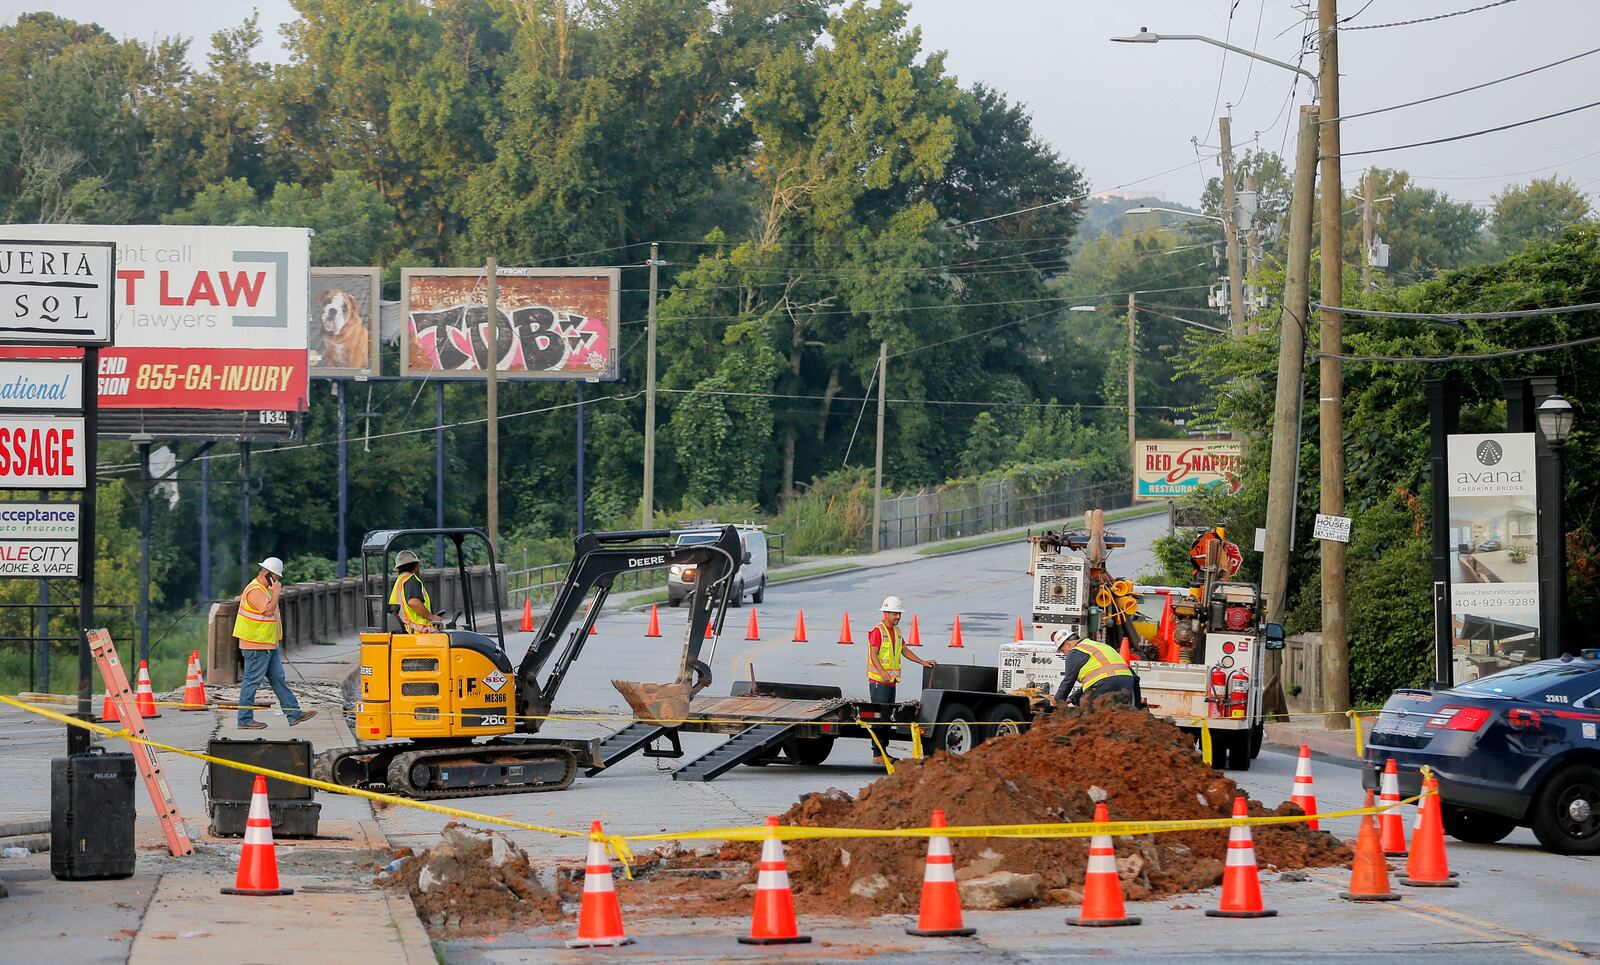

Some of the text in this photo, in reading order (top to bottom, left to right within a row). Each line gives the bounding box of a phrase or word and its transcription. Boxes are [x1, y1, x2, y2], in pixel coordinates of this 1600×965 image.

[155, 244, 192, 263] call
[160, 270, 267, 308] LAW
[132, 309, 217, 331] lawyers
[136, 364, 294, 392] 855-GA-INJURY
[0, 374, 70, 401] ational
[260, 411, 287, 424] 134
[1146, 454, 1171, 471] RED
[1457, 471, 1522, 483] avana
[0, 509, 75, 525] cceptance
[1317, 519, 1350, 530] HOUSES
[628, 555, 665, 568] DEERE
[31, 563, 40, 573] &
[43, 563, 75, 574] VAPE
[1456, 598, 1536, 607] 404-929-9289
[1004, 658, 1021, 667] AC172
[467, 677, 476, 692] F
[485, 693, 506, 703] ME366
[1545, 694, 1568, 704] 32418
[480, 714, 506, 726] 26G
